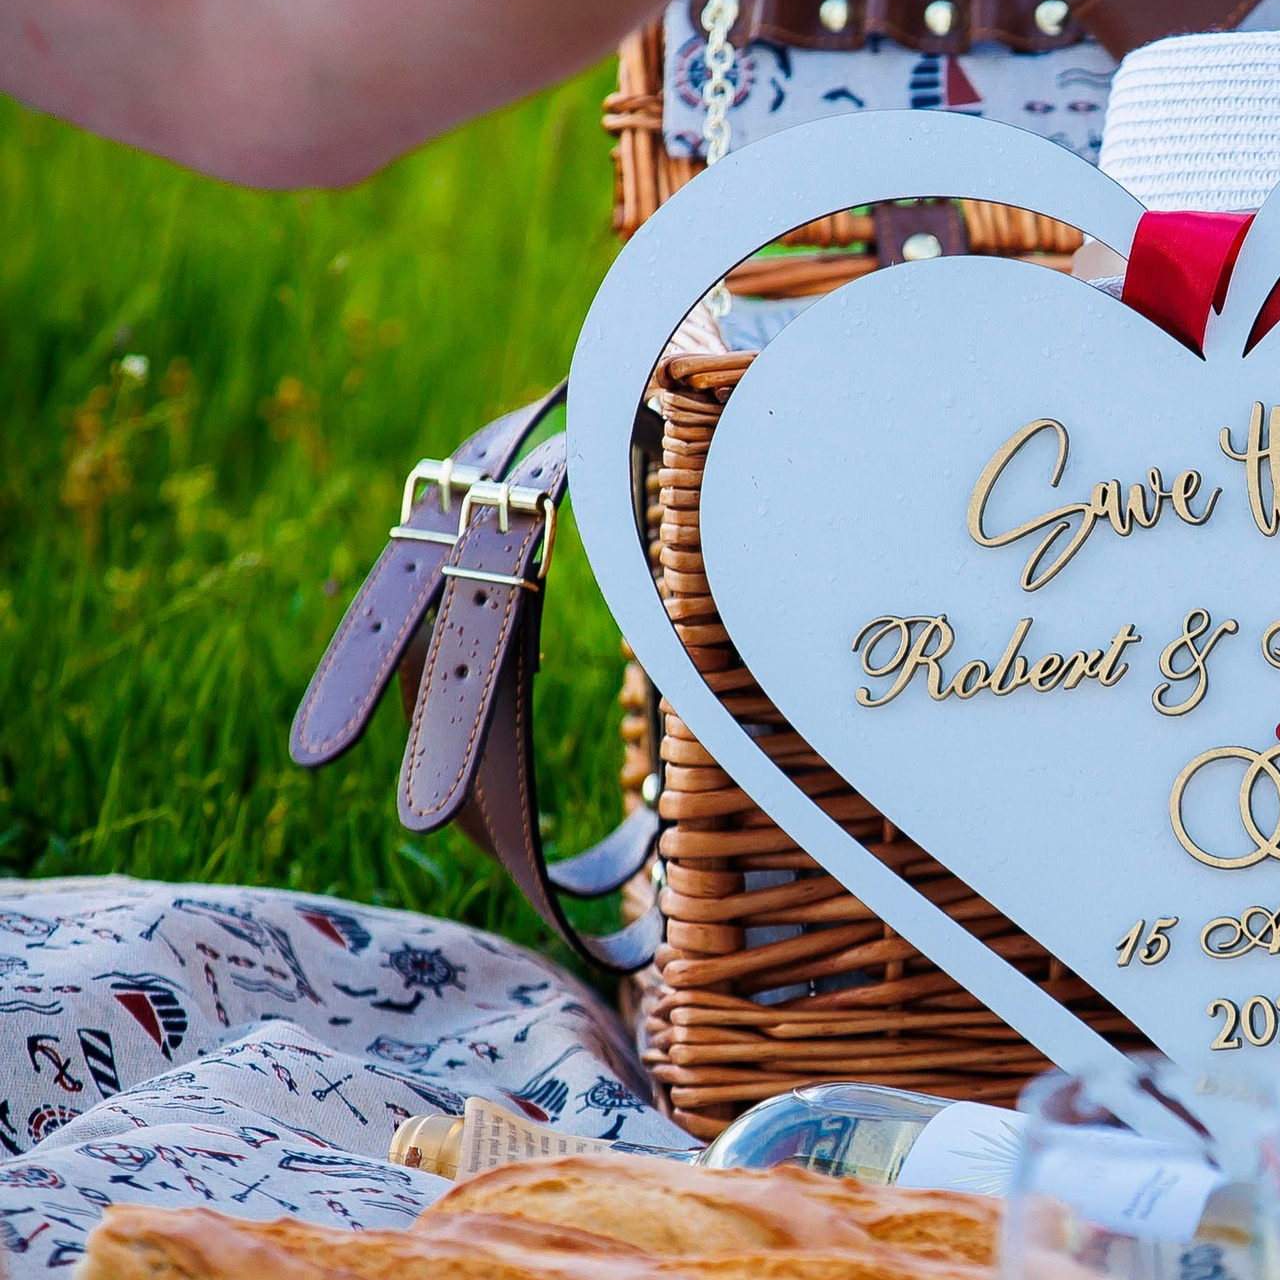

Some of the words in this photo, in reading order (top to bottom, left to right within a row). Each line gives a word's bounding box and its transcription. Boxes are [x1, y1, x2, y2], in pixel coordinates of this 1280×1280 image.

[968, 418, 1222, 592] Save
[852, 613, 1142, 708] Robert
[1151, 608, 1240, 717] &
[1115, 917, 1179, 968] 15
